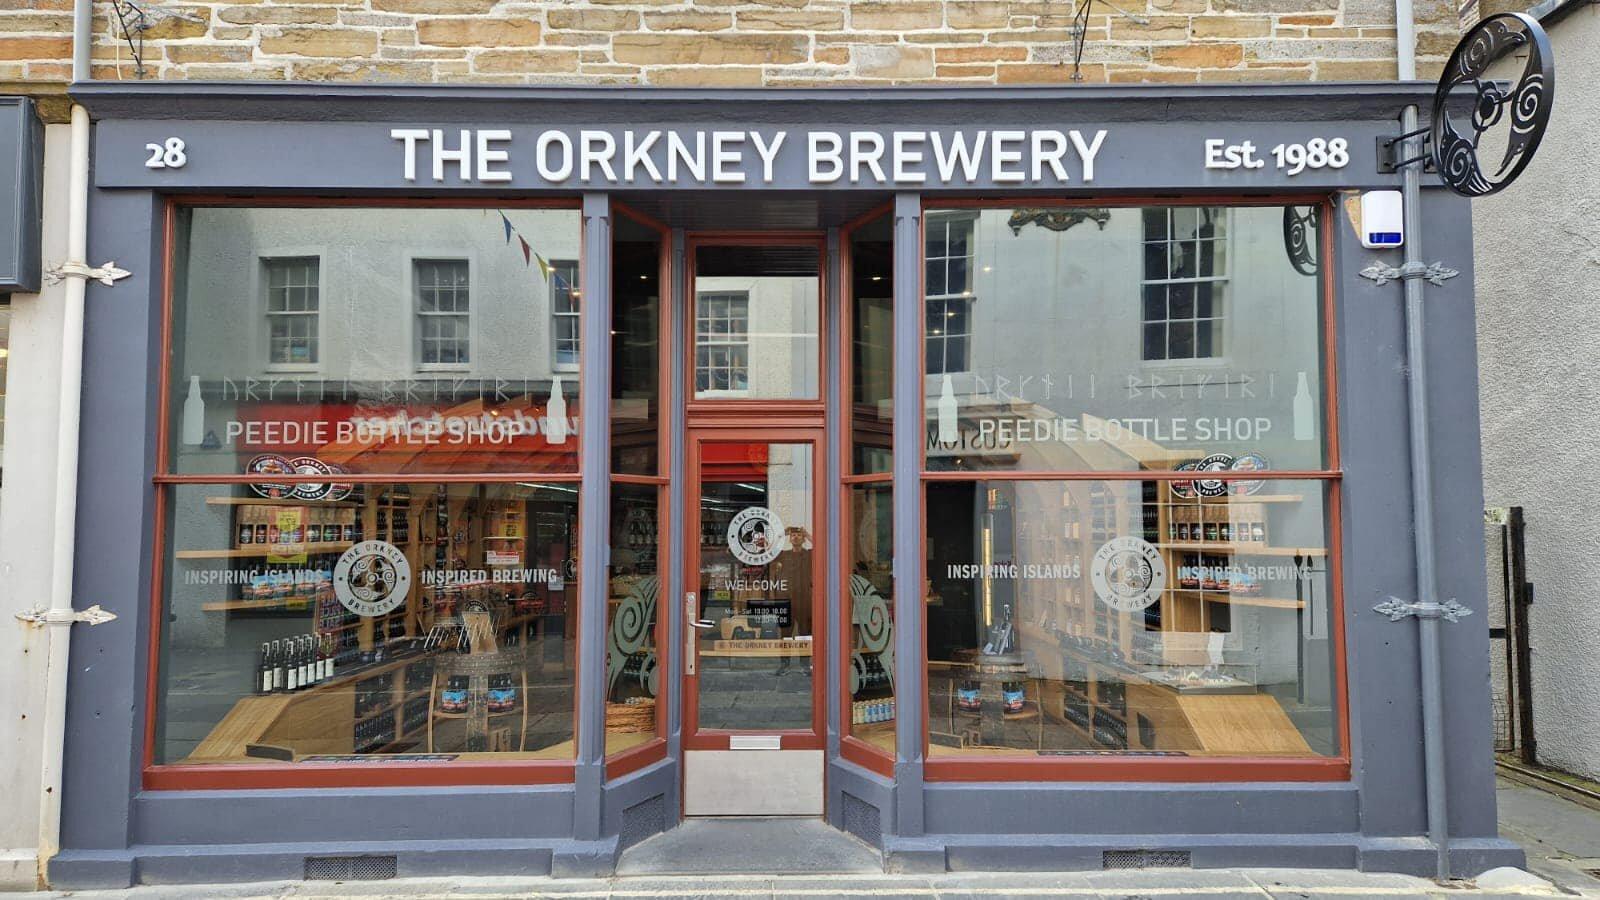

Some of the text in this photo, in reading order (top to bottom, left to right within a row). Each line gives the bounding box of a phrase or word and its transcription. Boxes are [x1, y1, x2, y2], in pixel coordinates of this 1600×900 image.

[145, 137, 187, 169] 28
[391, 129, 1108, 185] THE ORKNEY BREWERY
[1204, 136, 1350, 176] Est. 1988
[226, 421, 525, 445] PEEDIE BOTTLE SHOP
[979, 417, 1272, 442] PEEDIE BOTTLE SHOP
[184, 569, 262, 585] INSPIRING
[421, 568, 558, 585] INSPIRED BREWING
[947, 563, 1081, 580] INSPIRING ISLANDS
[1177, 564, 1312, 581] INSPIRED BREWING
[724, 579, 788, 592] WELCOME
